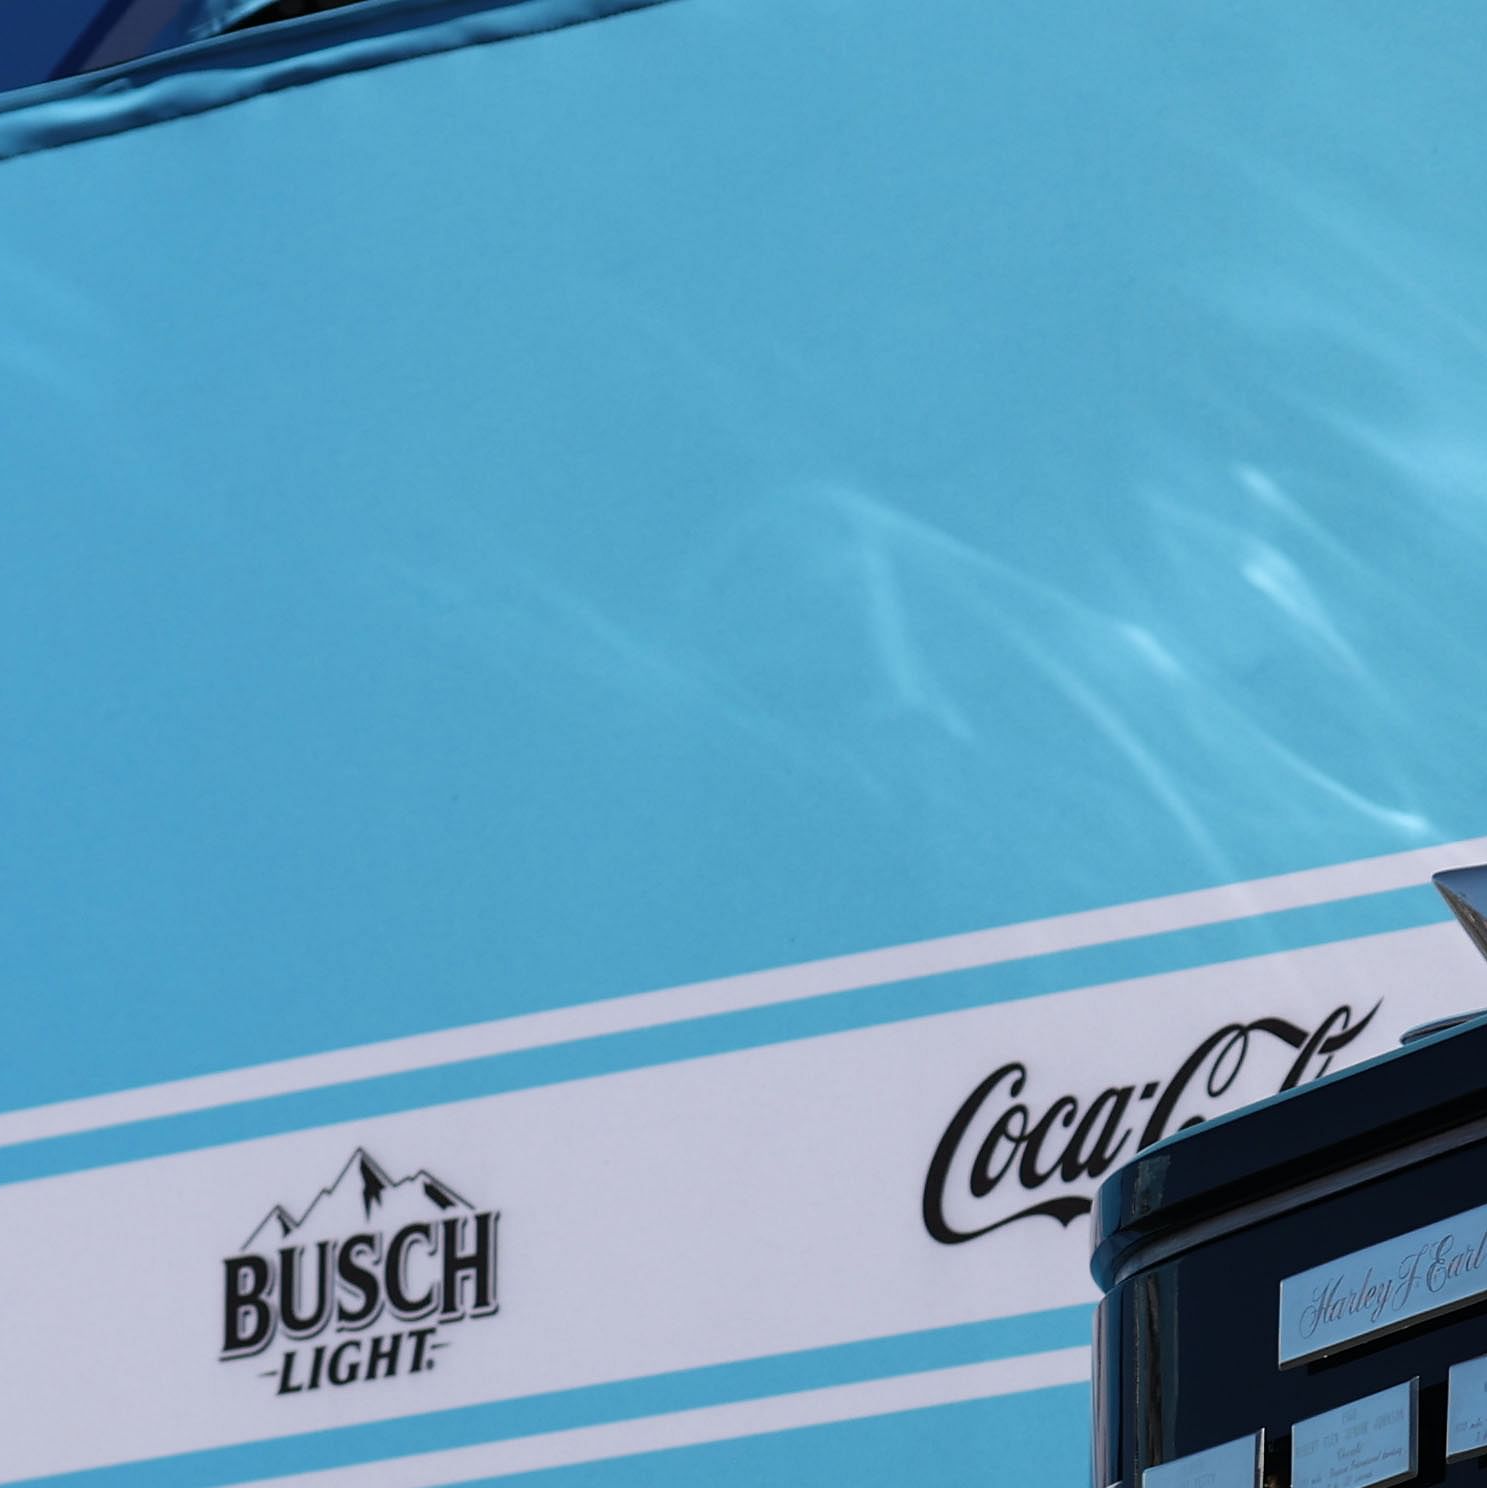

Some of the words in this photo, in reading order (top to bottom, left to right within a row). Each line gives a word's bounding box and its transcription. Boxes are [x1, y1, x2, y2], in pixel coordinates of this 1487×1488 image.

[220, 1211, 501, 1362] BUSCH
[1299, 1273, 1393, 1339] Harley
[277, 1327, 436, 1395] LIGHT
